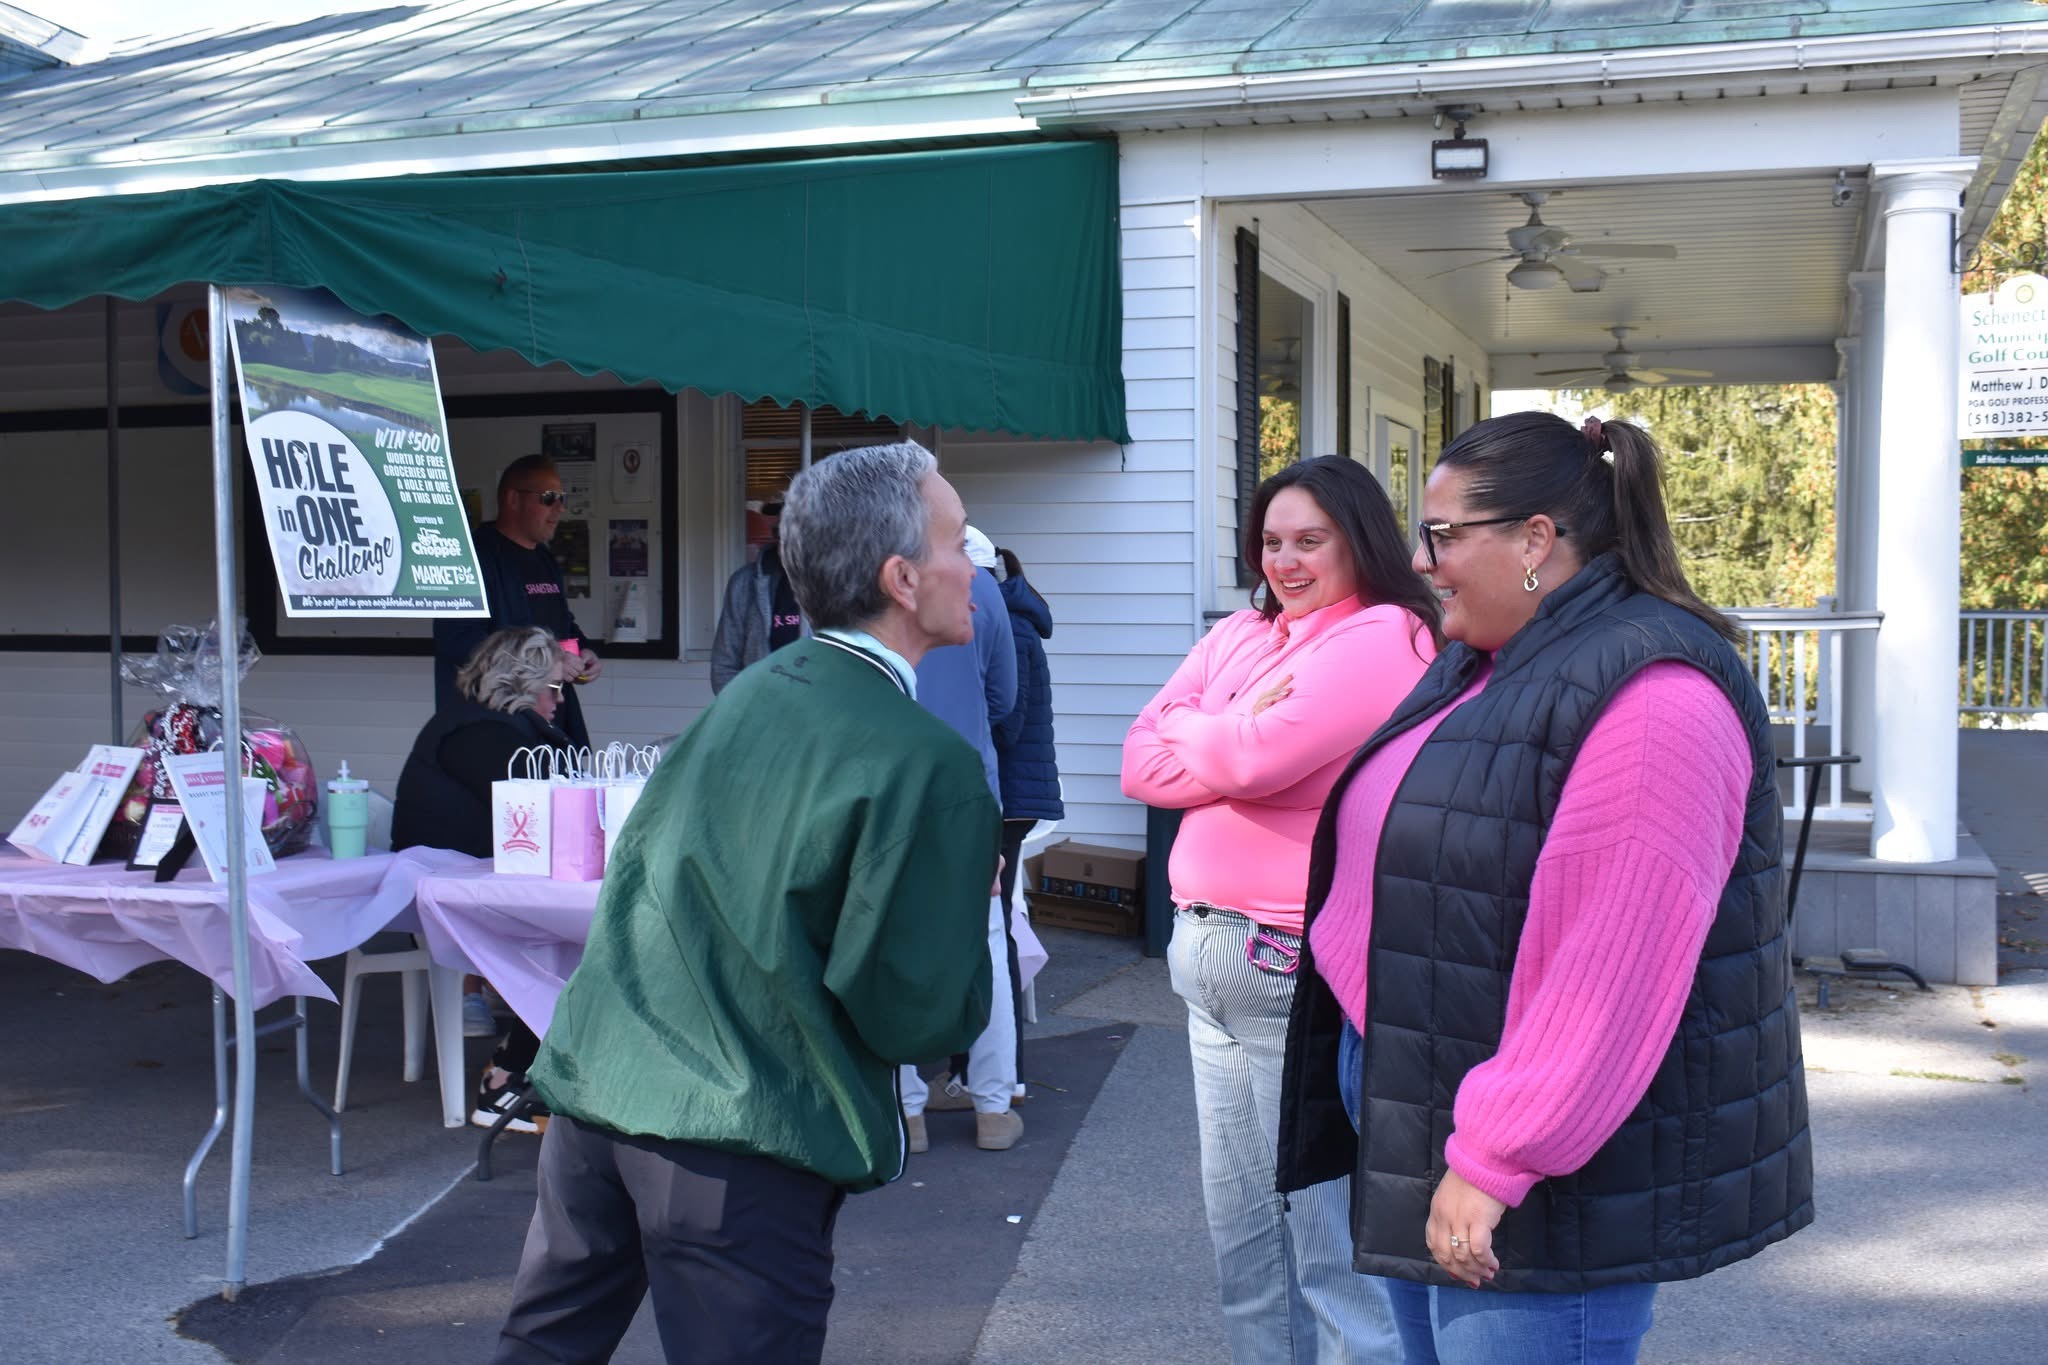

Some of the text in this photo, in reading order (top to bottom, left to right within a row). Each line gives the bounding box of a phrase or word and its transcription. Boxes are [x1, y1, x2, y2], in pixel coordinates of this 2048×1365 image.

[1968, 348, 2048, 364] Golf Cou
[1970, 377, 2023, 392] Matthew
[1968, 399, 1985, 407] PGA
[1988, 398, 2010, 407] GOLF
[375, 427, 441, 453] WIN $500
[261, 438, 355, 493] HOLE
[386, 452, 445, 467] WORTH OF FREE
[383, 464, 448, 480] GROCERIES WITH
[397, 478, 450, 493] A HOLE IN ONE
[400, 491, 454, 505] ON THIS HOLE!
[277, 495, 370, 546] in ONE
[298, 535, 394, 580] Challenge
[411, 541, 462, 558] Chopper
